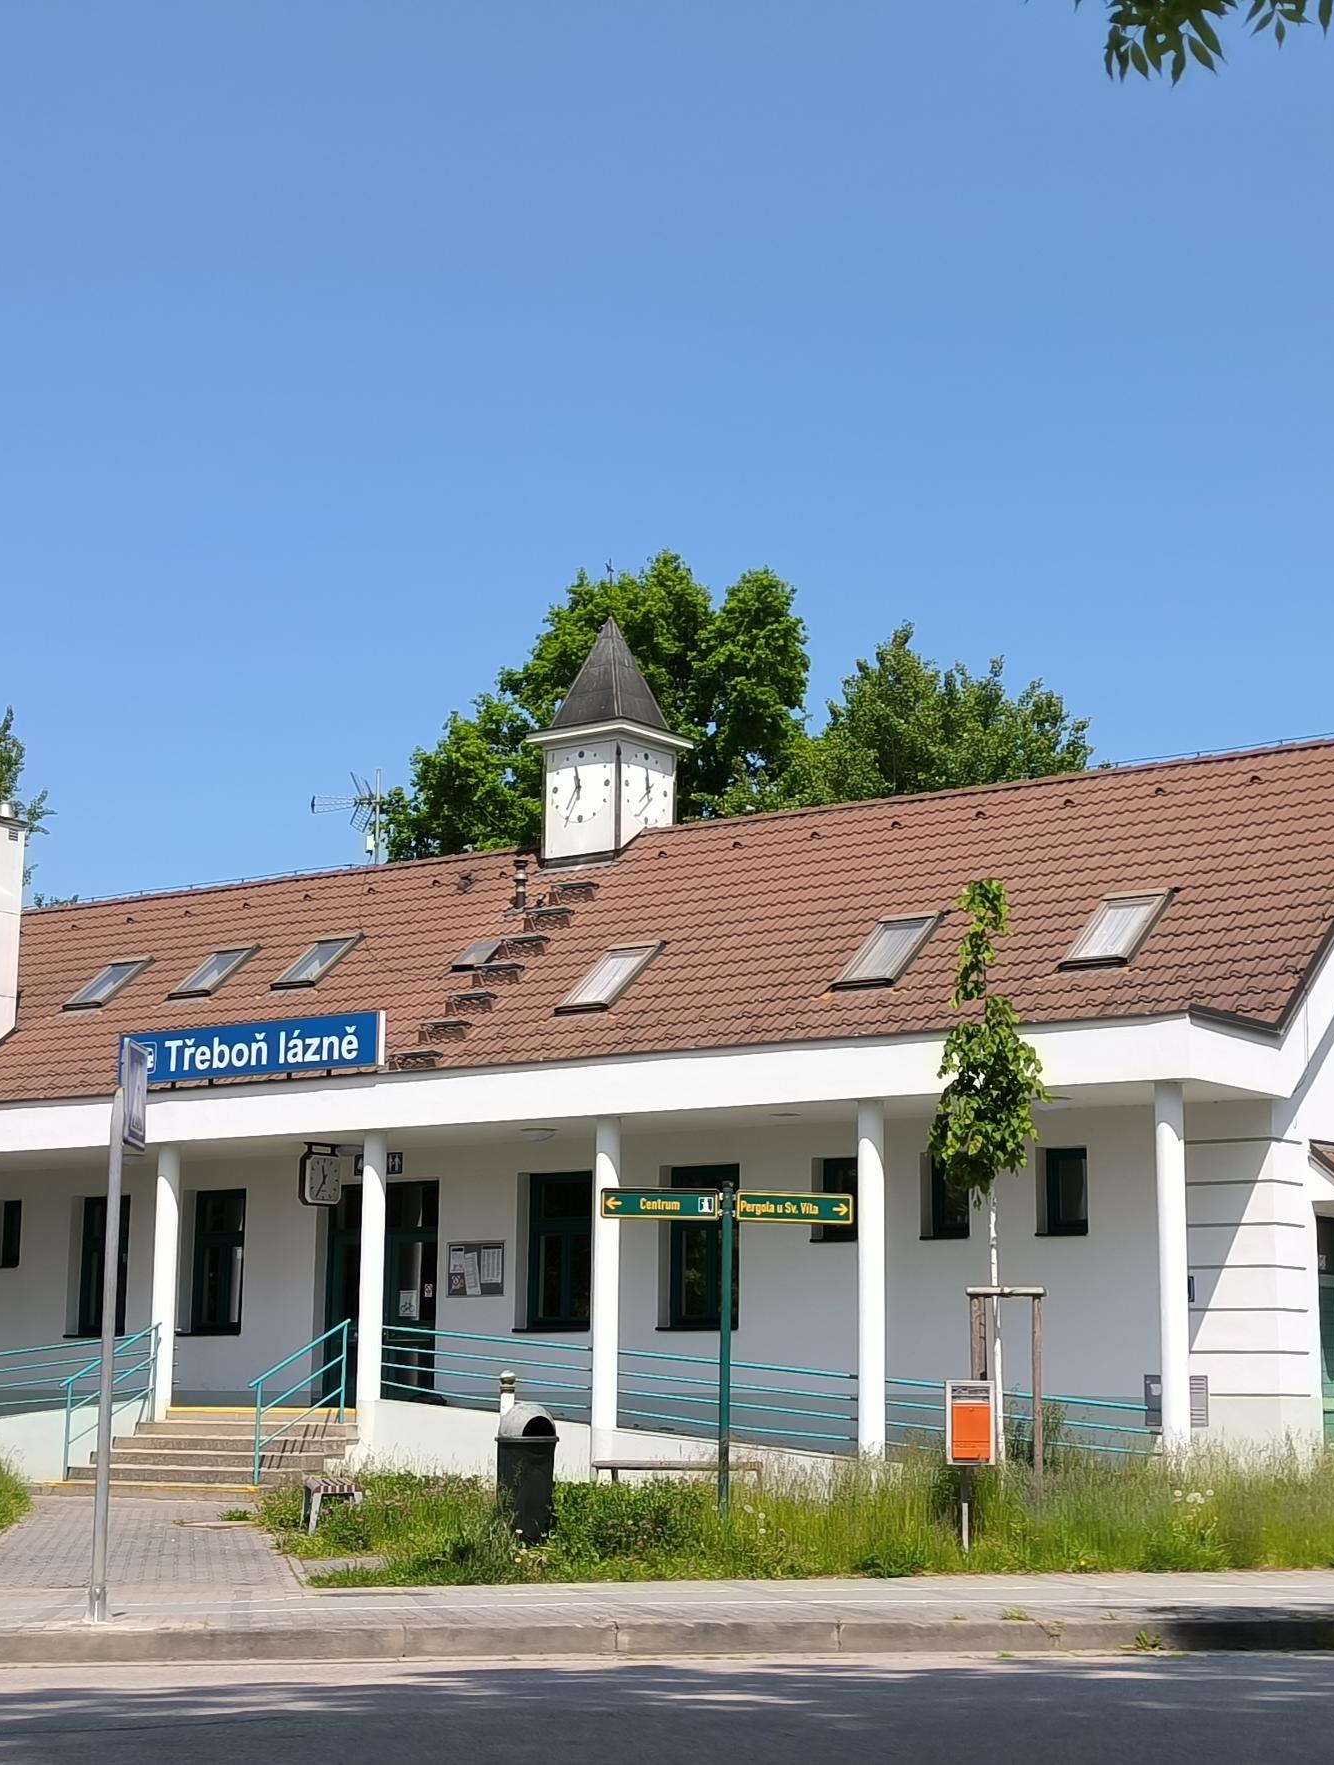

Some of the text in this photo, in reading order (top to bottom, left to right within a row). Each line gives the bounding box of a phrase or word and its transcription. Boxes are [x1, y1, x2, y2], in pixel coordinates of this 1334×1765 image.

[165, 1025, 359, 1072] Třeboň lázně
[639, 1197, 681, 1211] Centrum
[740, 1200, 775, 1216] Pergola
[776, 1203, 784, 1213] u
[784, 1202, 799, 1214] Sv.
